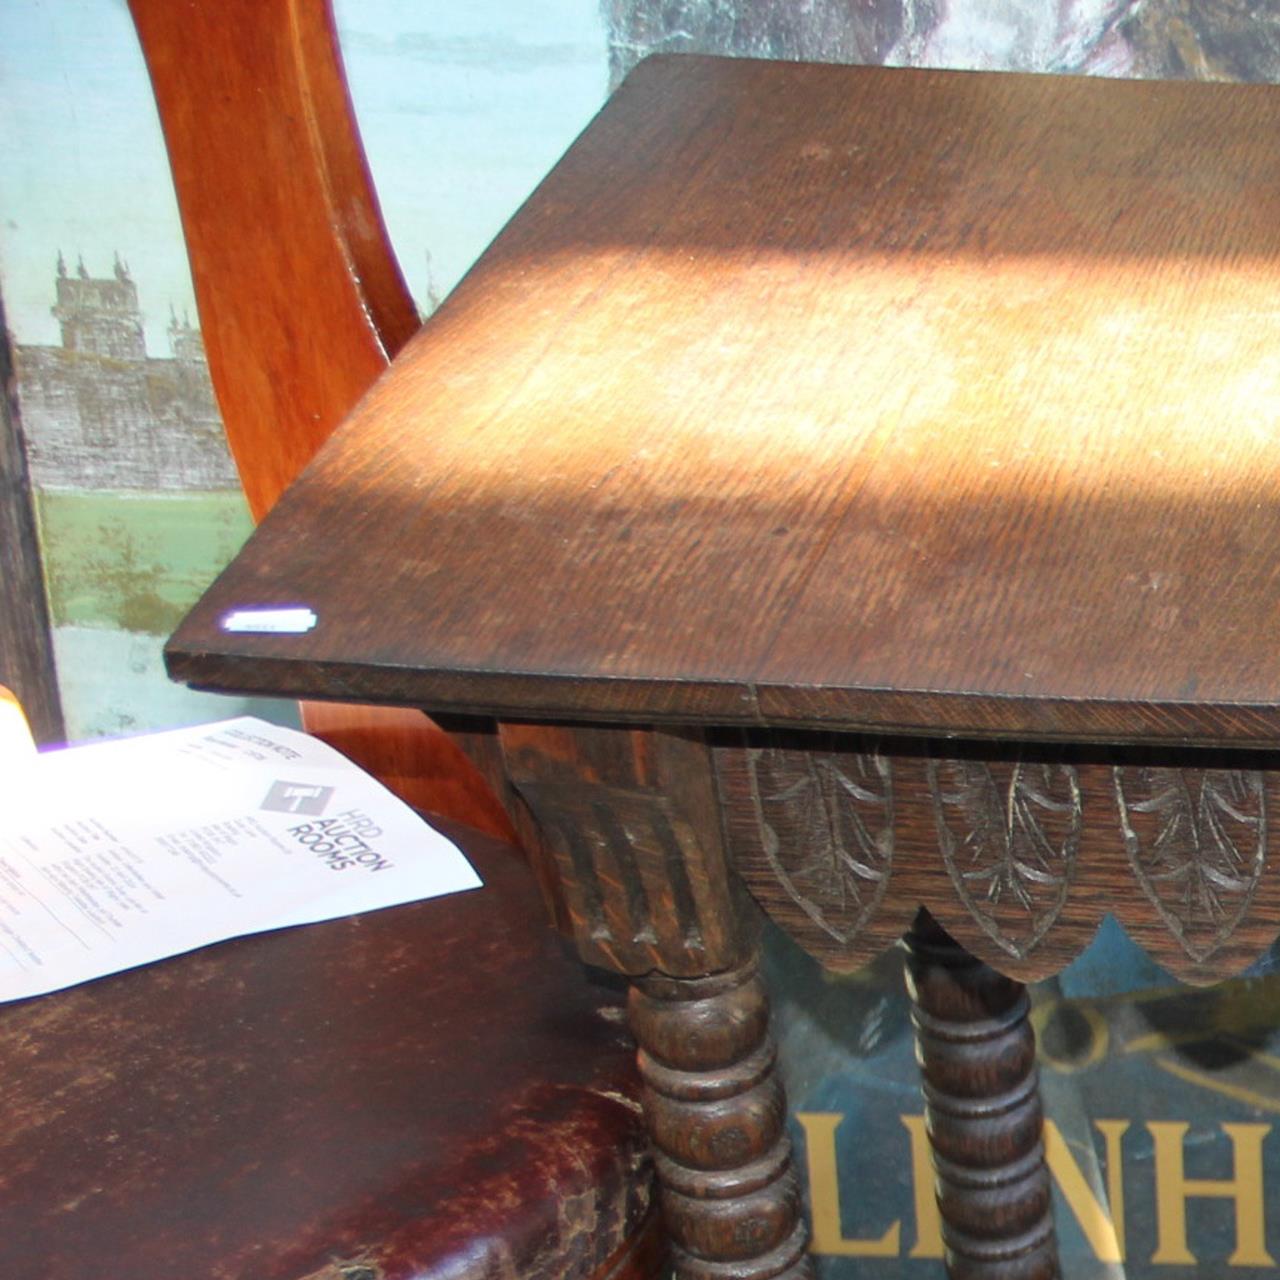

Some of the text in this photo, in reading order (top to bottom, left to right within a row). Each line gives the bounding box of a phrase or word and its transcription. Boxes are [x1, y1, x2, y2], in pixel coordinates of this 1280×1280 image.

[286, 823, 356, 871] ROOMS
[312, 818, 396, 873] AUCTION
[337, 808, 384, 839] HRD
